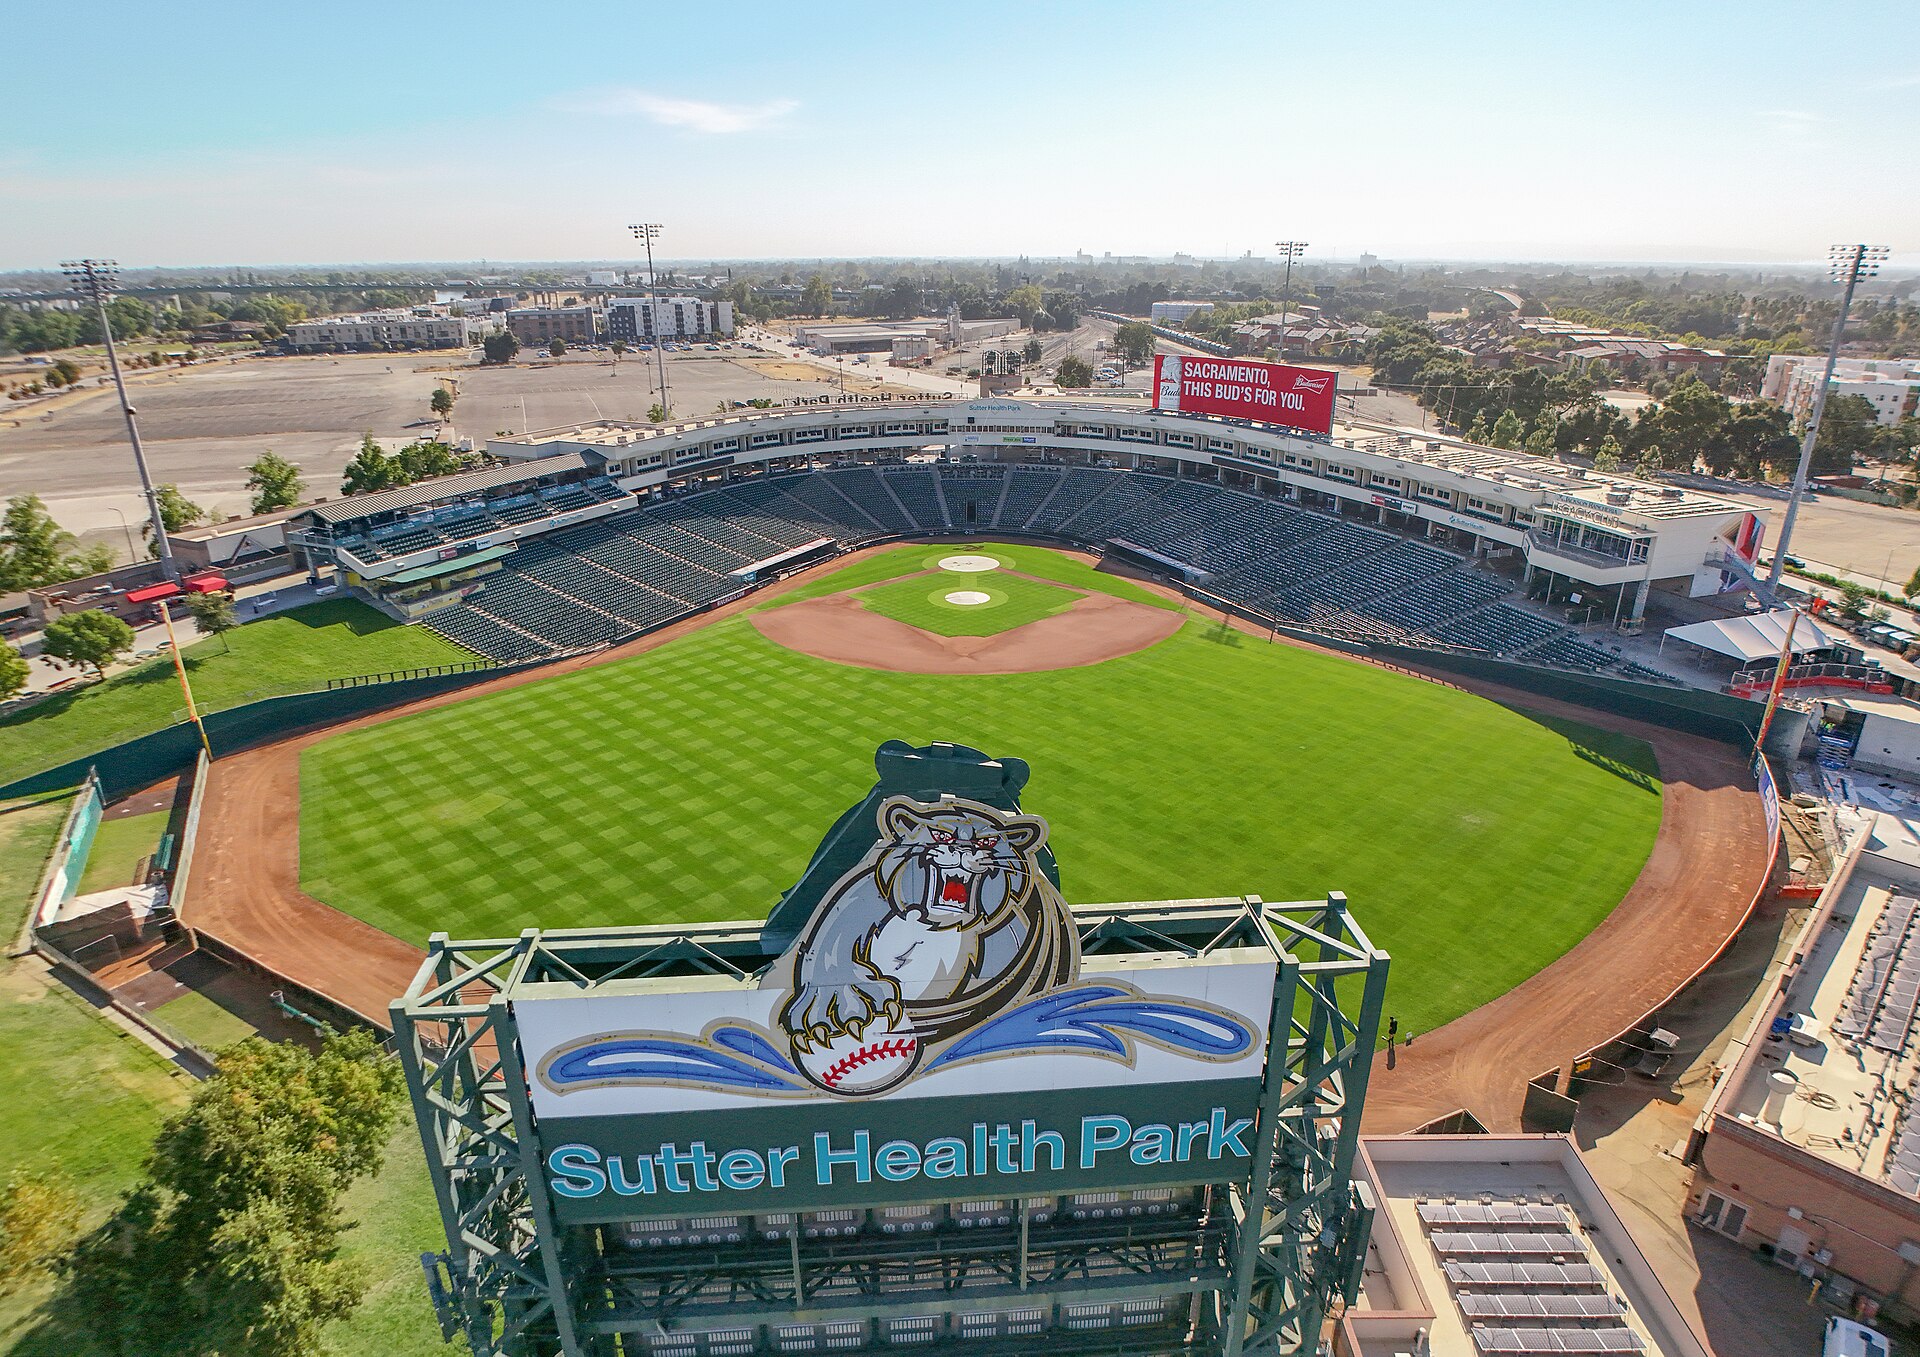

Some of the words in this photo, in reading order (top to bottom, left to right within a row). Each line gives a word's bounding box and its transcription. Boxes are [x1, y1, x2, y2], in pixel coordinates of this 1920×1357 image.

[1183, 361, 1271, 388] SACRAMENTO,
[1295, 377, 1324, 389] Budweiser
[1183, 380, 1212, 398] THIS
[1214, 384, 1252, 404] BUD'S
[1254, 389, 1277, 407] FOR
[1280, 392, 1306, 412] YOU.
[1592, 511, 1620, 528] CLUB
[547, 1139, 800, 1200] Sutter
[813, 1118, 1066, 1186] Health
[1079, 1106, 1253, 1170] Park
